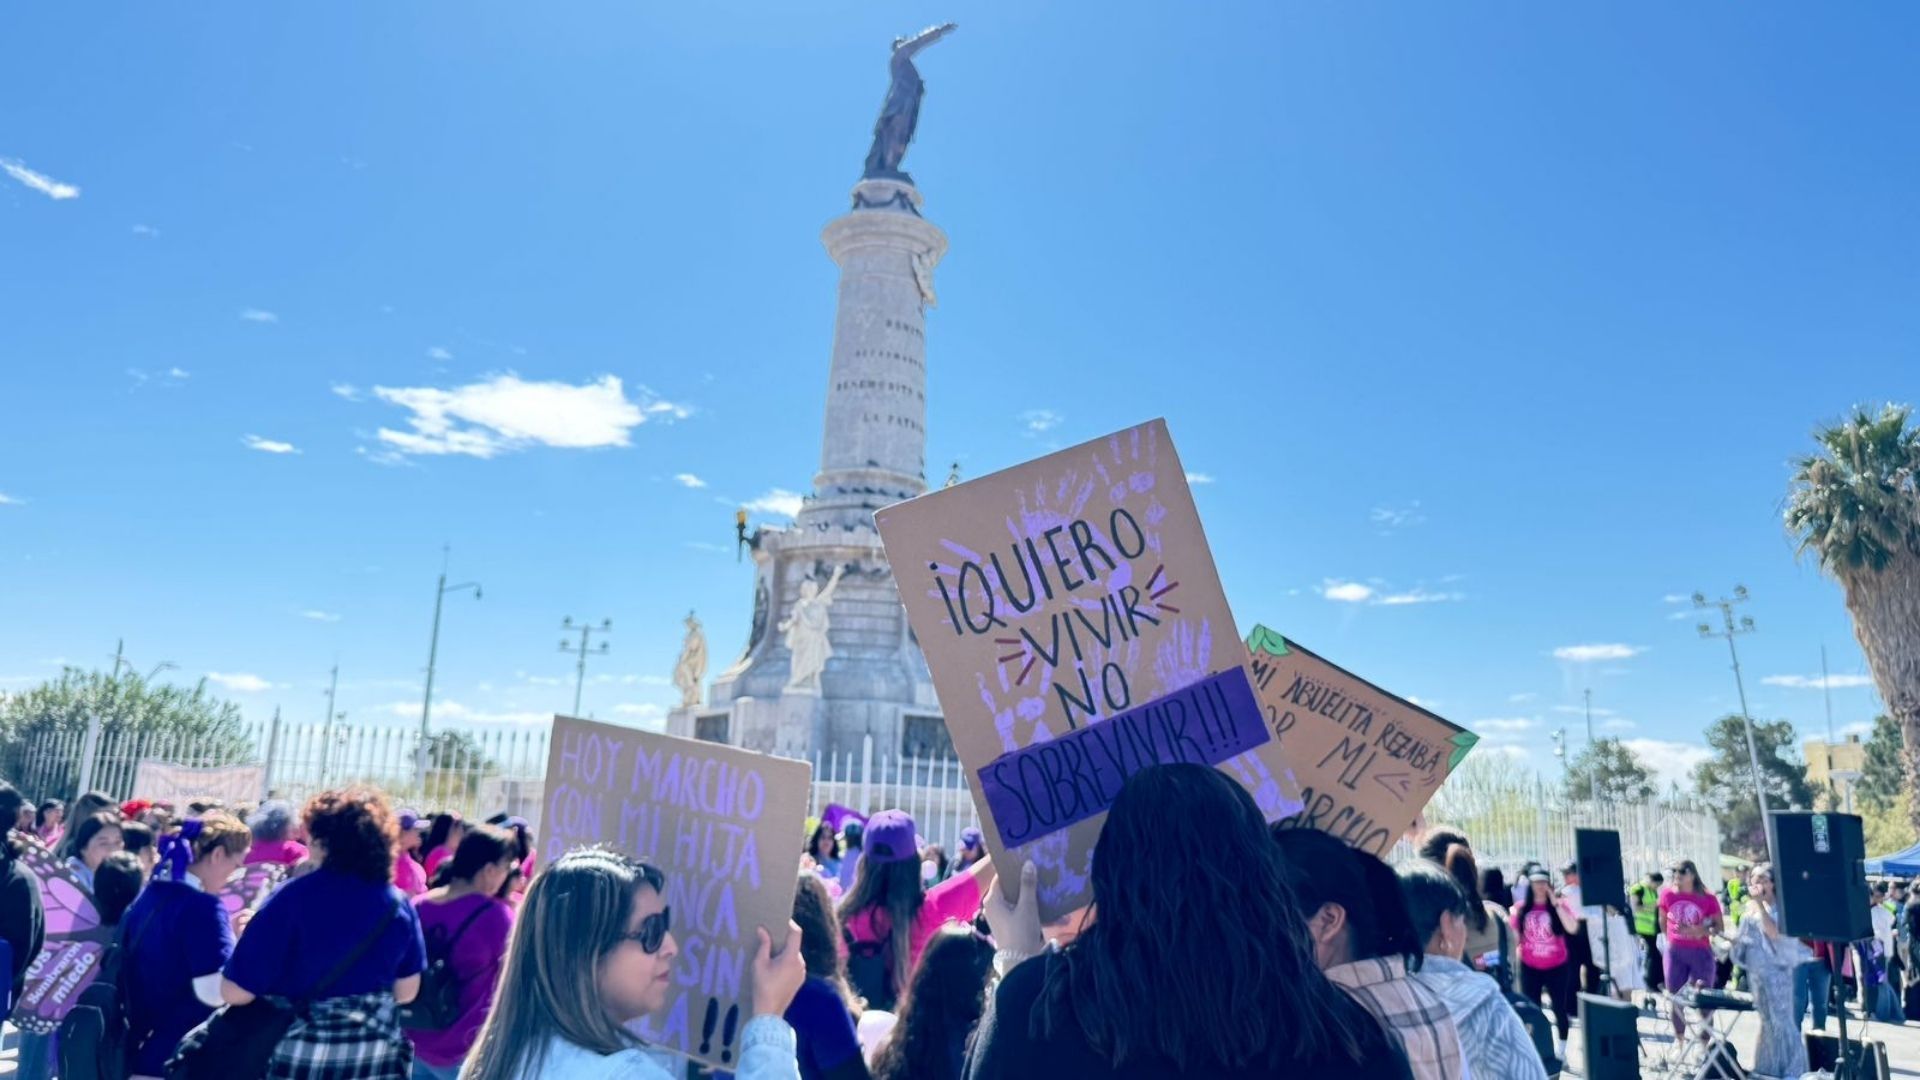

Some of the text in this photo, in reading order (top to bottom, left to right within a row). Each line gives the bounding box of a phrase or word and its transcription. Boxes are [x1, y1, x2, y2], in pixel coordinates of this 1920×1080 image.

[929, 508, 1145, 636] ¡QUIERO
[1019, 585, 1160, 667] VIVIR
[1053, 662, 1130, 730] NO
[1252, 659, 1441, 773] MI ABUELITA REZABA
[560, 730, 765, 823] HOY MARCHO
[1316, 737, 1376, 791] MI
[551, 783, 762, 891] CON MI HIJA
[52, 952, 95, 1004] miedo
[675, 934, 746, 1000] SIN
